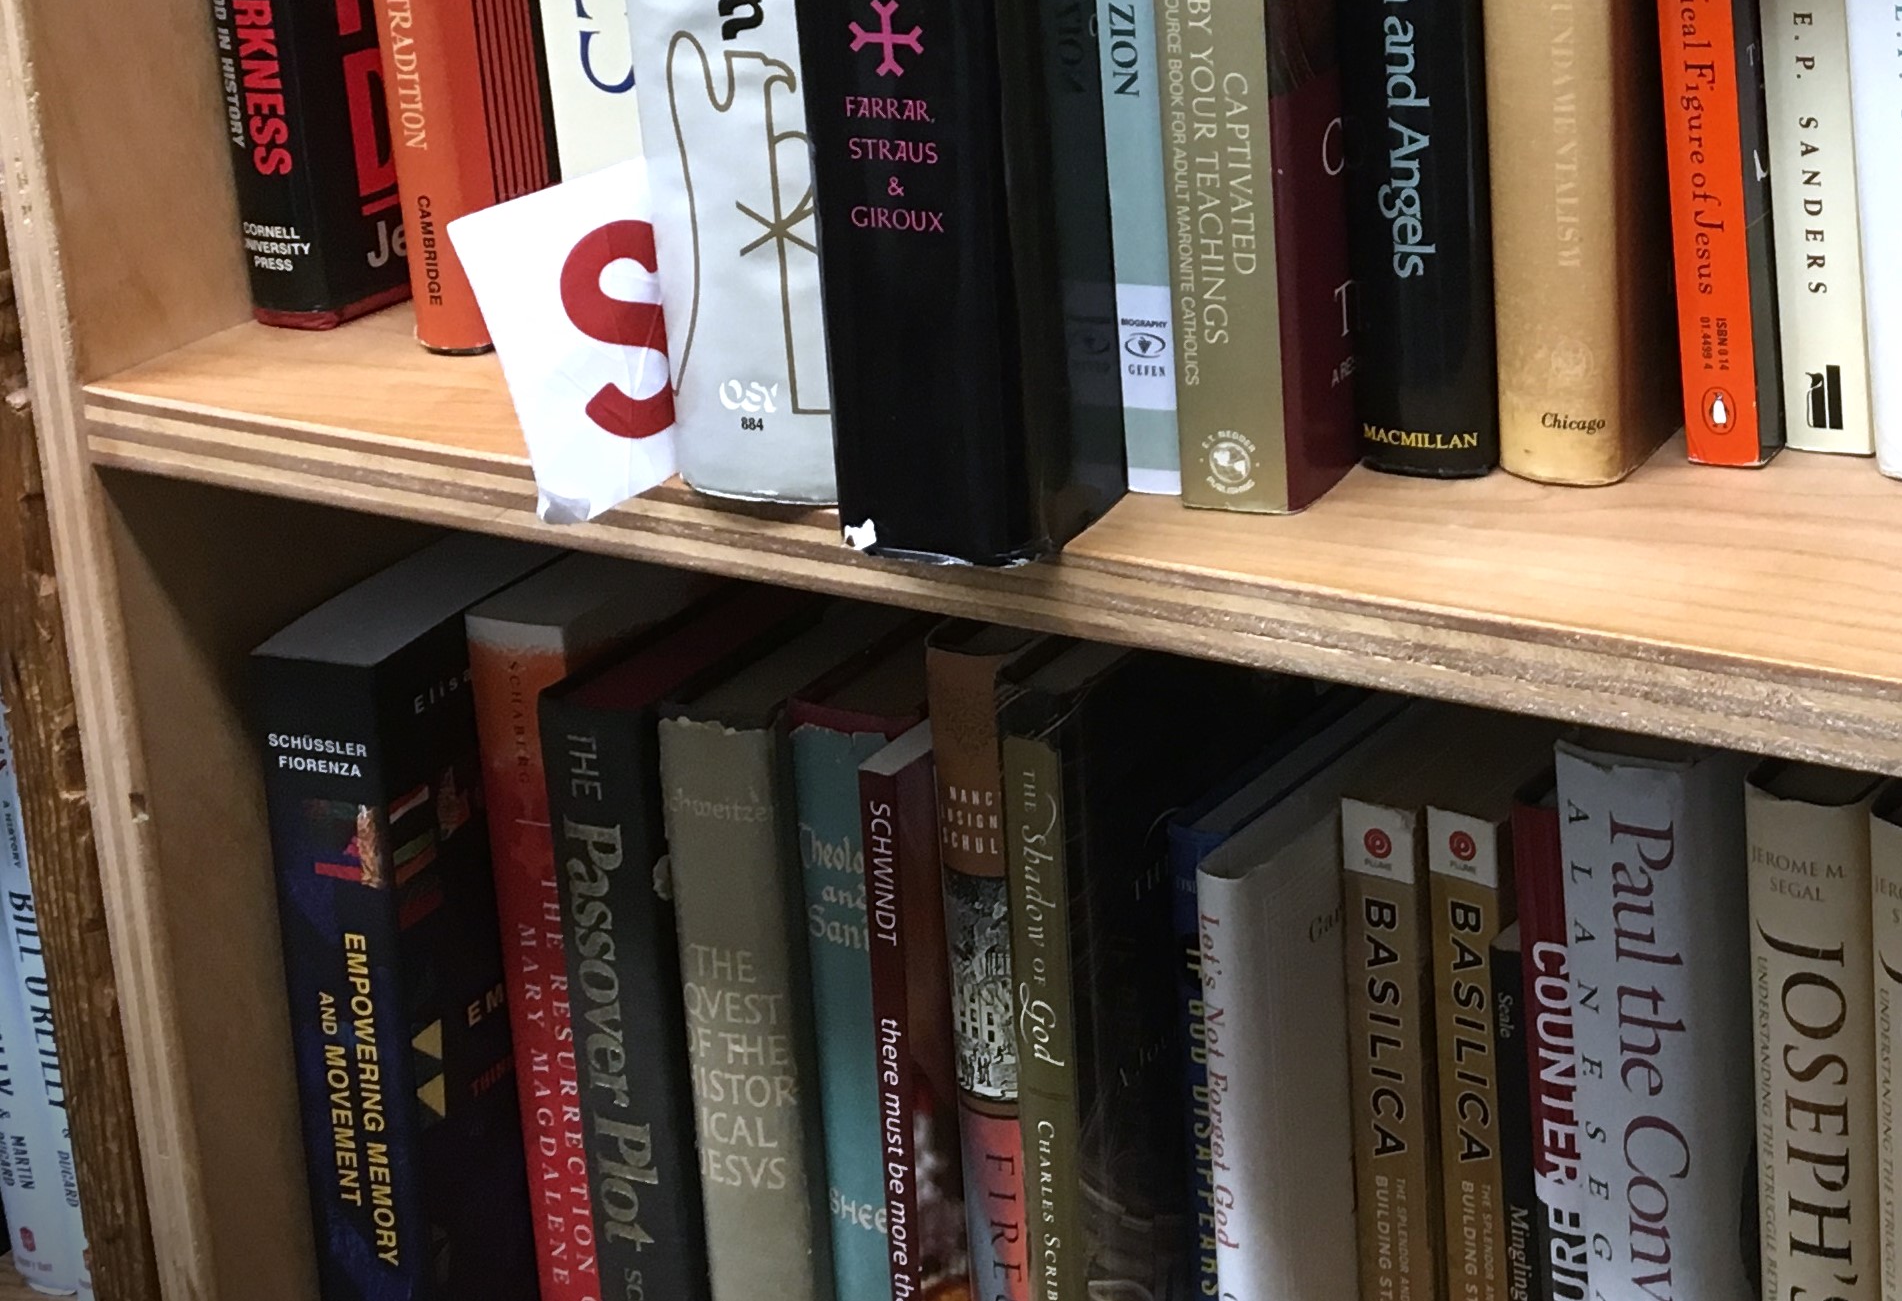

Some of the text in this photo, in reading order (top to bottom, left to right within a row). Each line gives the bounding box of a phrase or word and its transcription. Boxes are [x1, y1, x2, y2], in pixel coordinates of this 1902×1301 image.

[1108, 7, 1140, 98] ZION
[1383, 15, 1430, 108] and
[848, 137, 938, 166] STRAUS
[1223, 72, 1257, 276] CAPTIVATED
[1378, 120, 1437, 279] Angels
[1798, 117, 1828, 295] SANDERS
[416, 195, 442, 306] CAMBRIDGE
[851, 205, 945, 234] GIROUX
[1196, 152, 1229, 346] TEACHINGS
[1183, 296, 1200, 386] CATHOLICS
[1362, 422, 1479, 449] MACMILLAN
[1541, 411, 1606, 433] Chicago
[268, 733, 367, 758] SCHÜSSLER
[278, 756, 361, 778] FIORENZA
[1752, 844, 1818, 878] JEROME
[1769, 877, 1825, 903] SEGAL
[563, 732, 659, 1253] THE Passover Plot
[1608, 811, 1686, 1097] Paul the
[540, 878, 596, 1275] THE RESURRECTION
[870, 801, 909, 1266] SCHWINDT there must be more
[1363, 896, 1408, 1159] BASILICA
[1448, 900, 1493, 1163] BASILICA
[319, 990, 363, 1206] AND MOVEMENT
[344, 932, 399, 1267] EMPOWERING MEMORY
[518, 922, 570, 1285] MARY MAGDALENE
[1036, 1120, 1055, 1223] CHARLES
